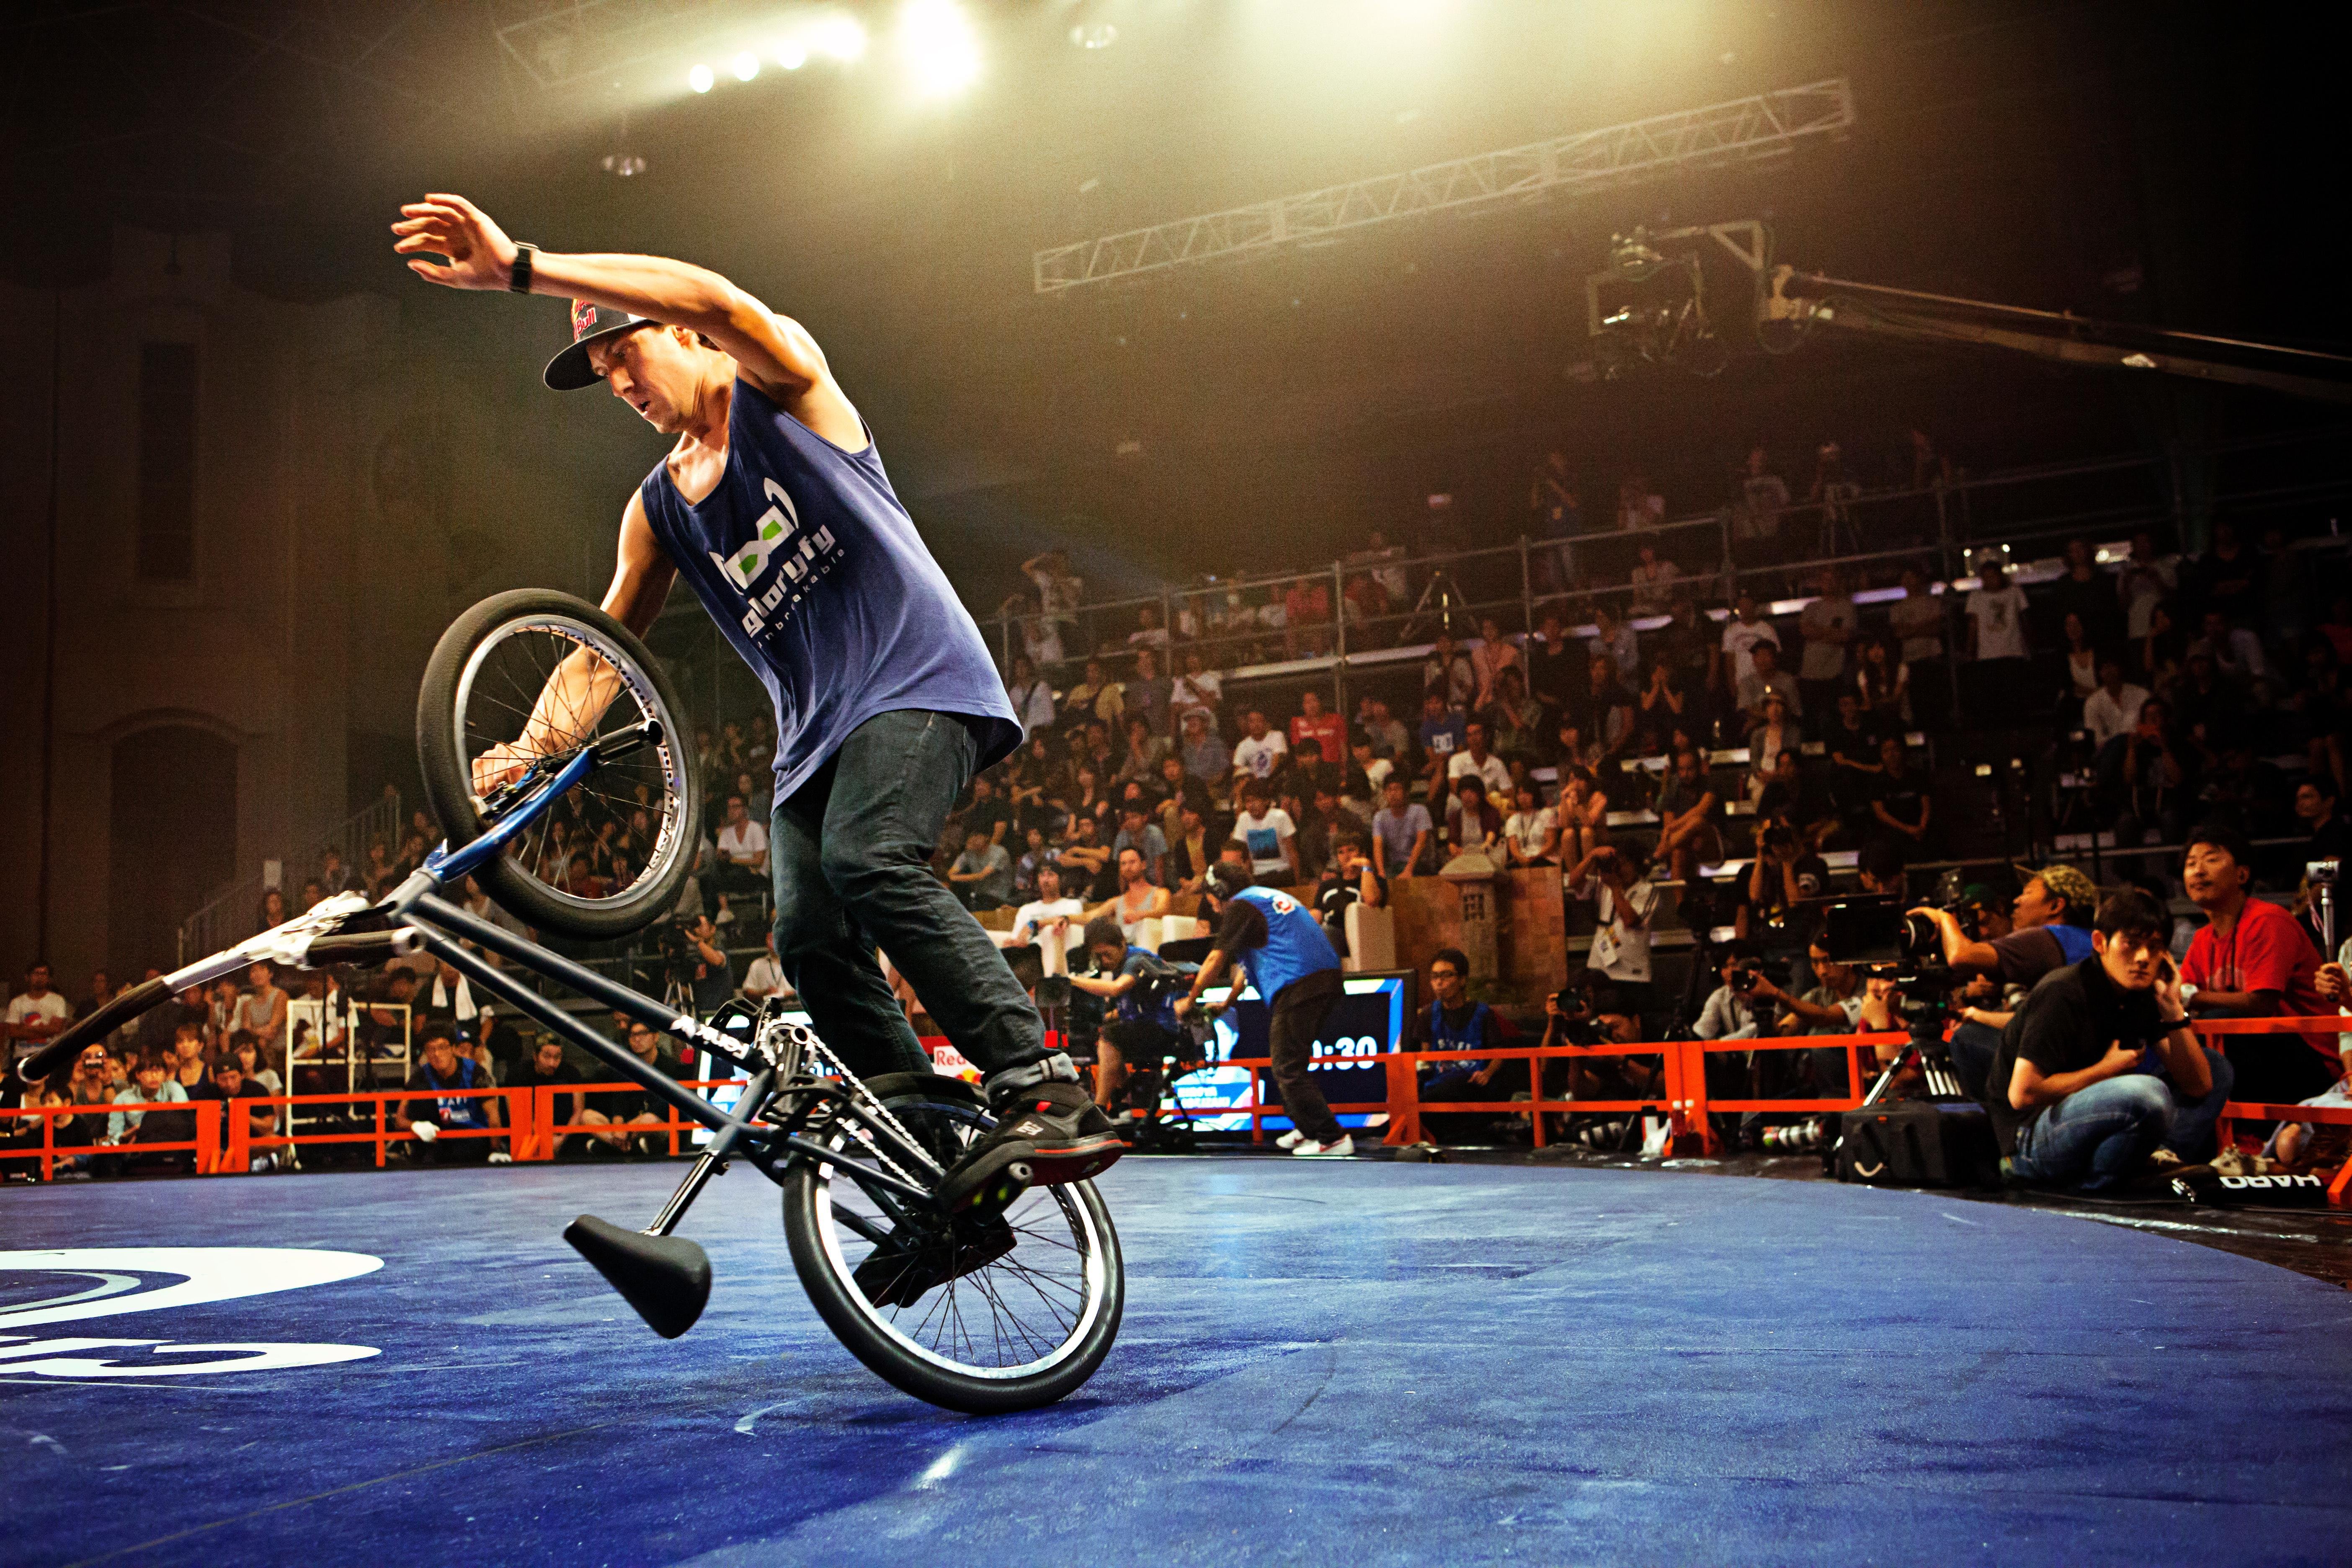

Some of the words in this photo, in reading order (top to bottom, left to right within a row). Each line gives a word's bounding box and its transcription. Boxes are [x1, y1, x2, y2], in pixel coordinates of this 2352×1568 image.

[575, 307, 597, 335] Bull
[742, 524, 836, 638] gloryfy
[2219, 1175, 2321, 1189] HARO
